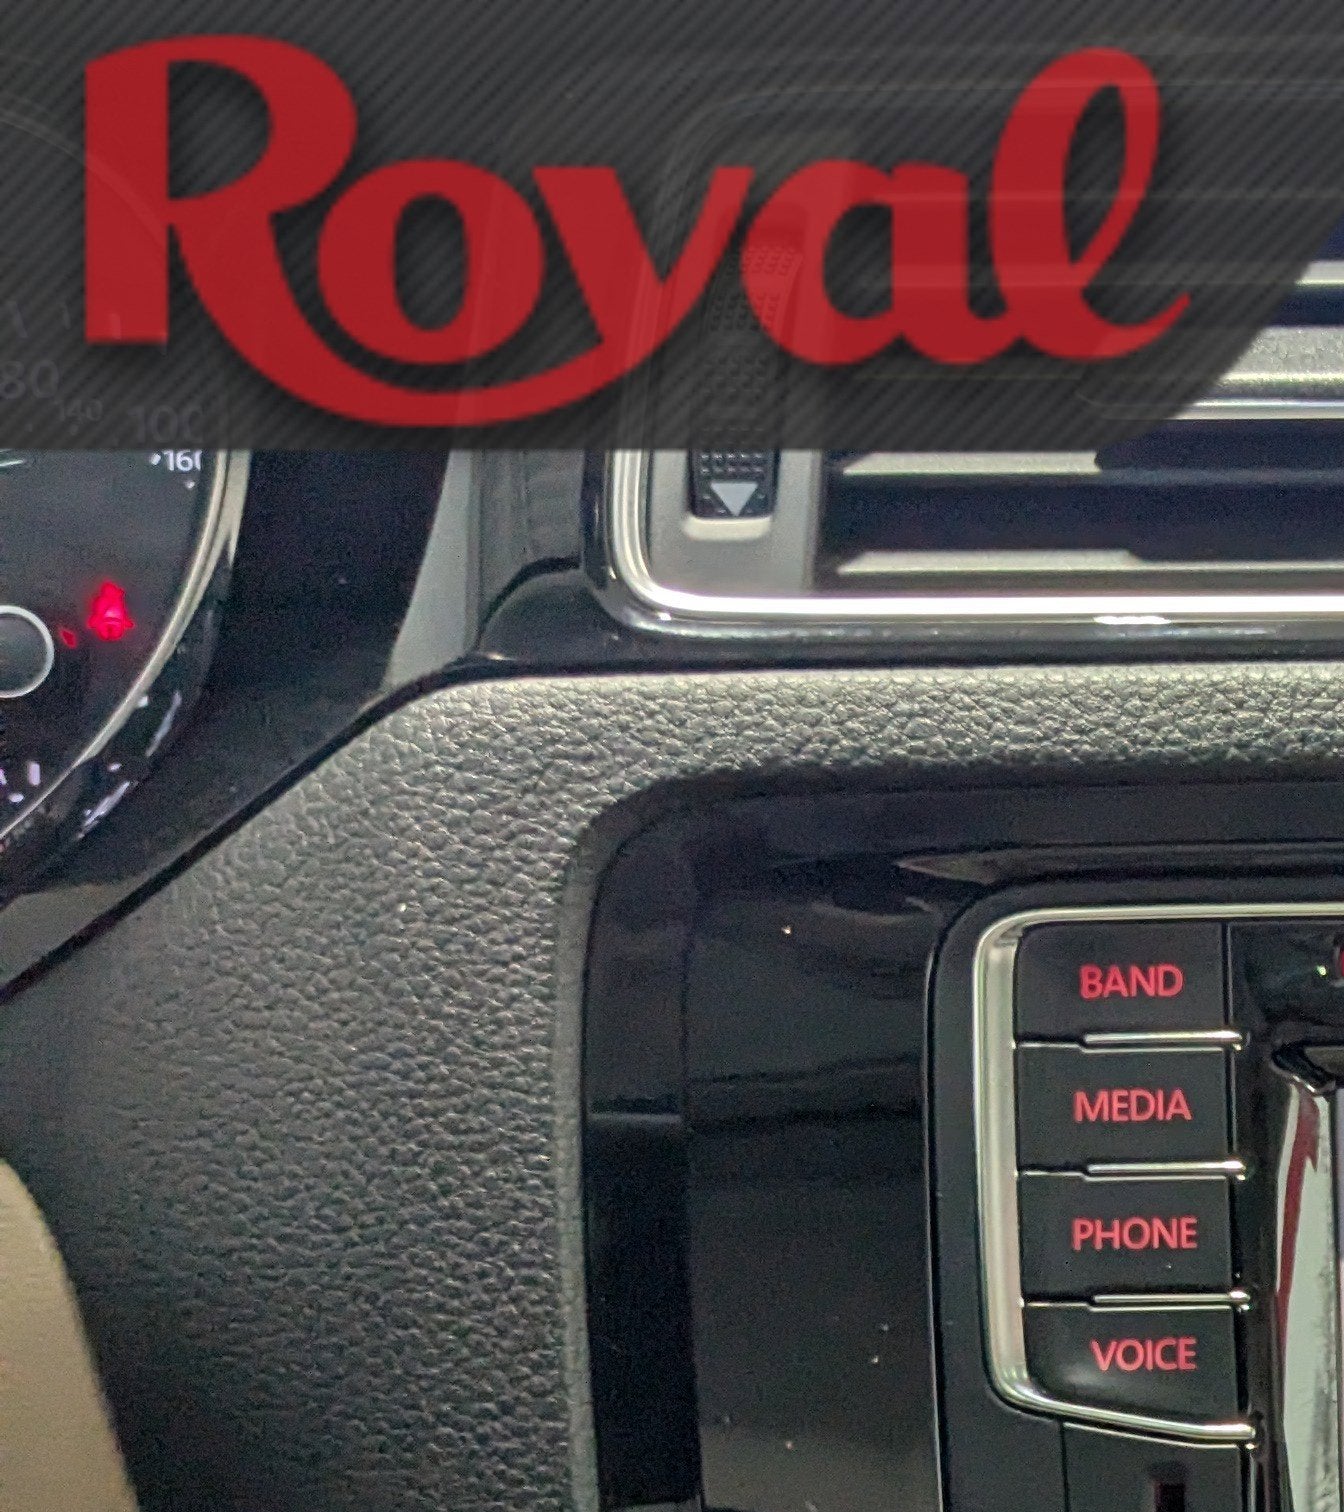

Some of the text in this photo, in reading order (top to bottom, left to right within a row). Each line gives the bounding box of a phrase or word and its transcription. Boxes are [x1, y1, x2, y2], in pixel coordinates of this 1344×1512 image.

[1079, 963, 1184, 999] BAND
[1073, 1087, 1193, 1123] MEDIA
[1071, 1217, 1198, 1251] PHONE
[1091, 1337, 1197, 1371] VOICE
